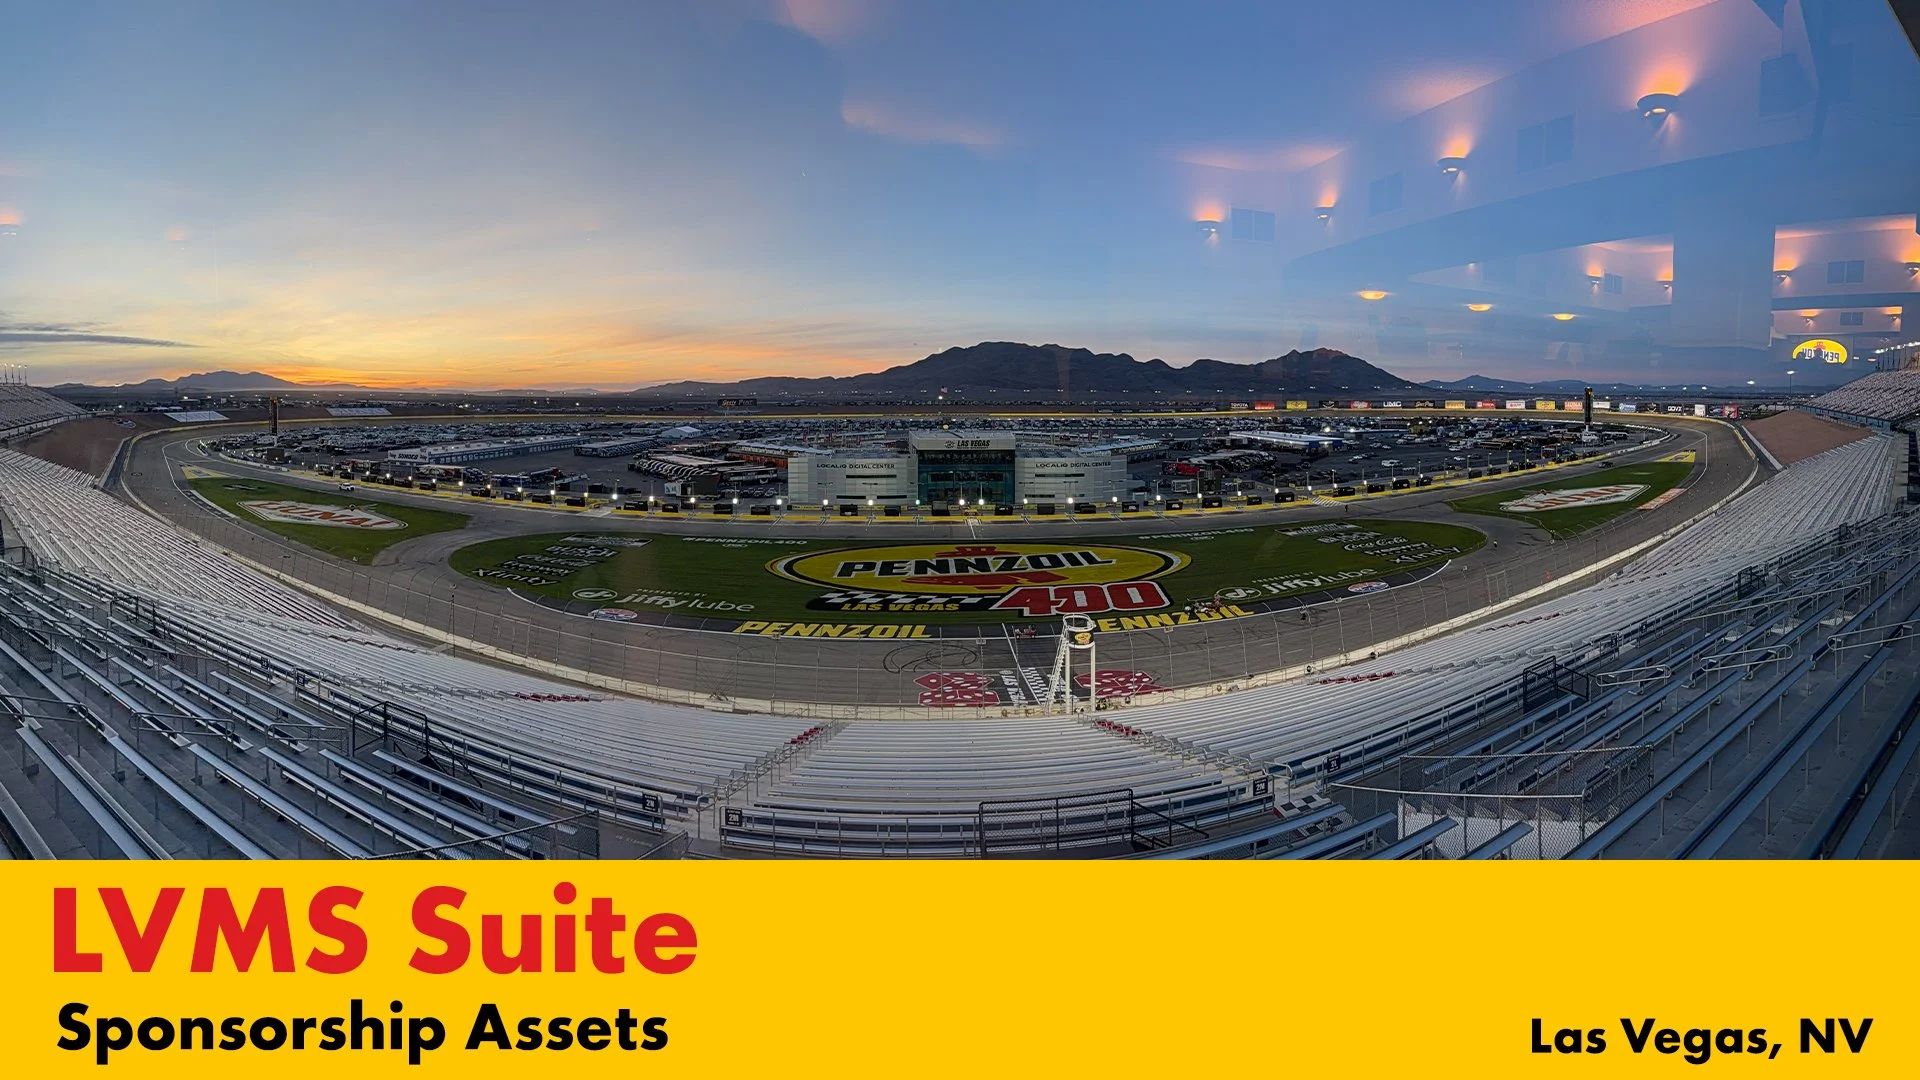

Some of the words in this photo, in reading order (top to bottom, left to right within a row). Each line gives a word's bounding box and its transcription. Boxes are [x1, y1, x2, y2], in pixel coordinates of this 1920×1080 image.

[833, 550, 1117, 578] PENNZOIL
[841, 603, 883, 611] LAS
[888, 603, 960, 611] VEGAS
[989, 580, 1171, 617] 400
[732, 620, 932, 638] PENNZOIL
[1097, 605, 1255, 632] ENNZOIL
